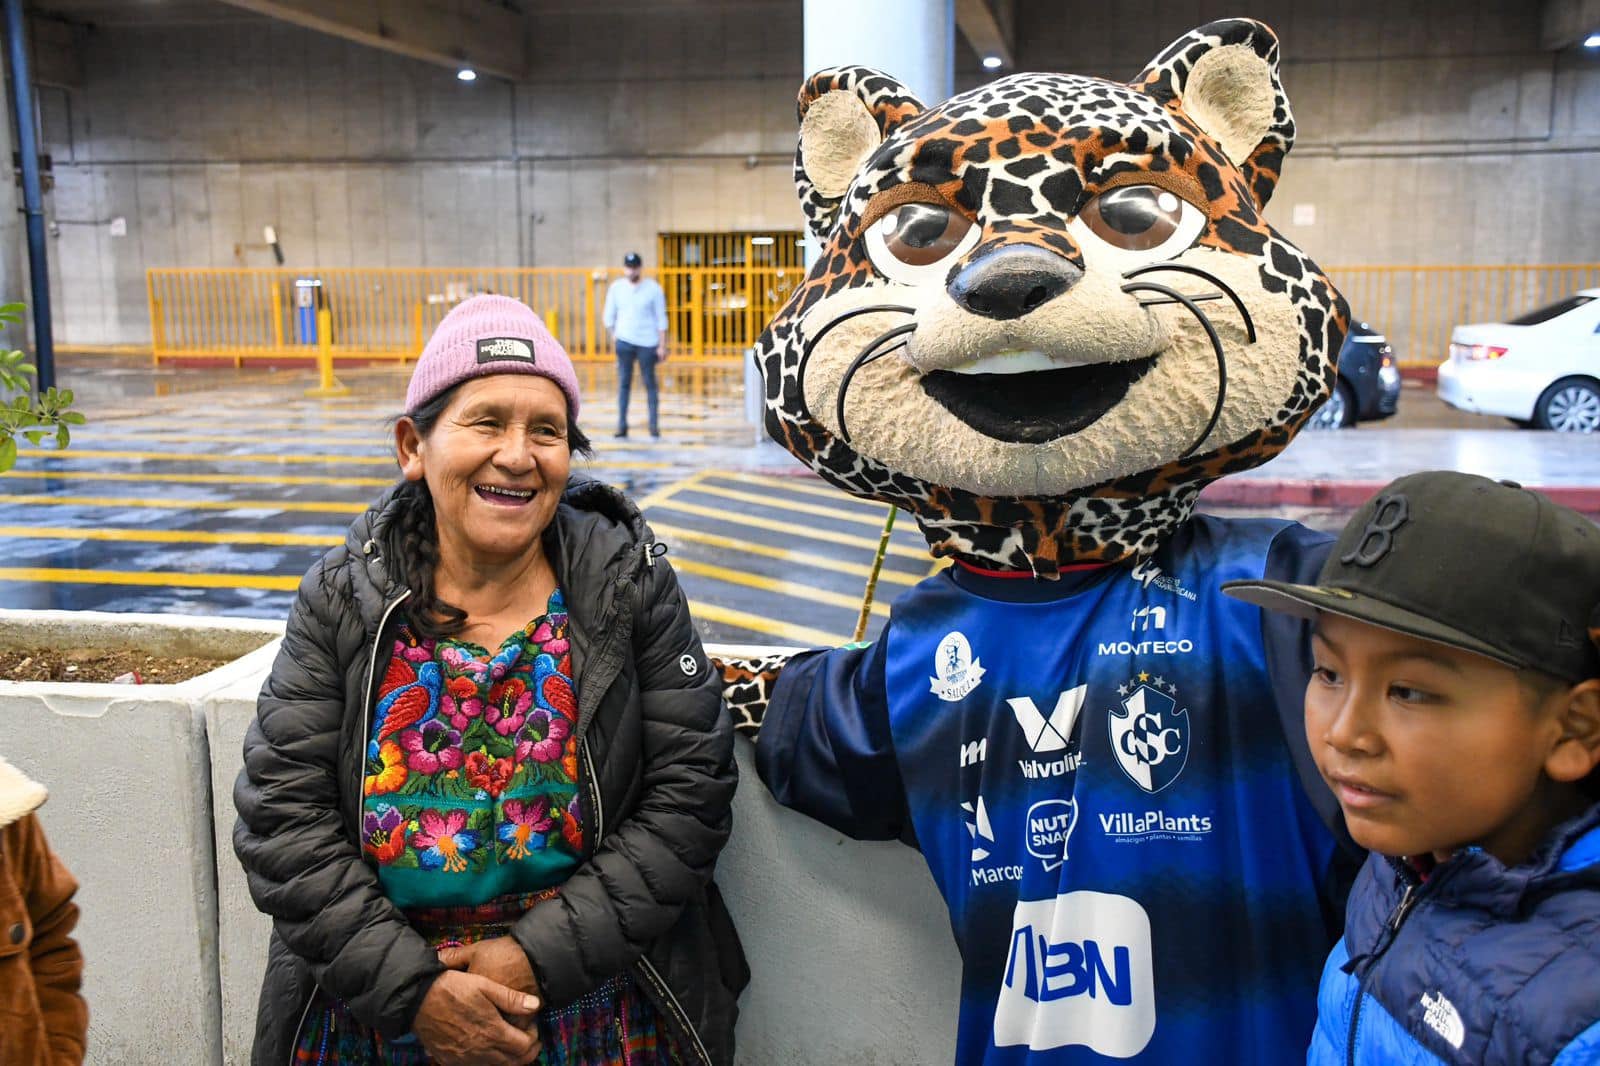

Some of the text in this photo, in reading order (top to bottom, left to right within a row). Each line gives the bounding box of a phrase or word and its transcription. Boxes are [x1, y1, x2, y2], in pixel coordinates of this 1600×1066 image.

[1341, 494, 1409, 567] B
[1098, 639, 1193, 656] MONTECO
[1098, 810, 1212, 833] VillaPlants
